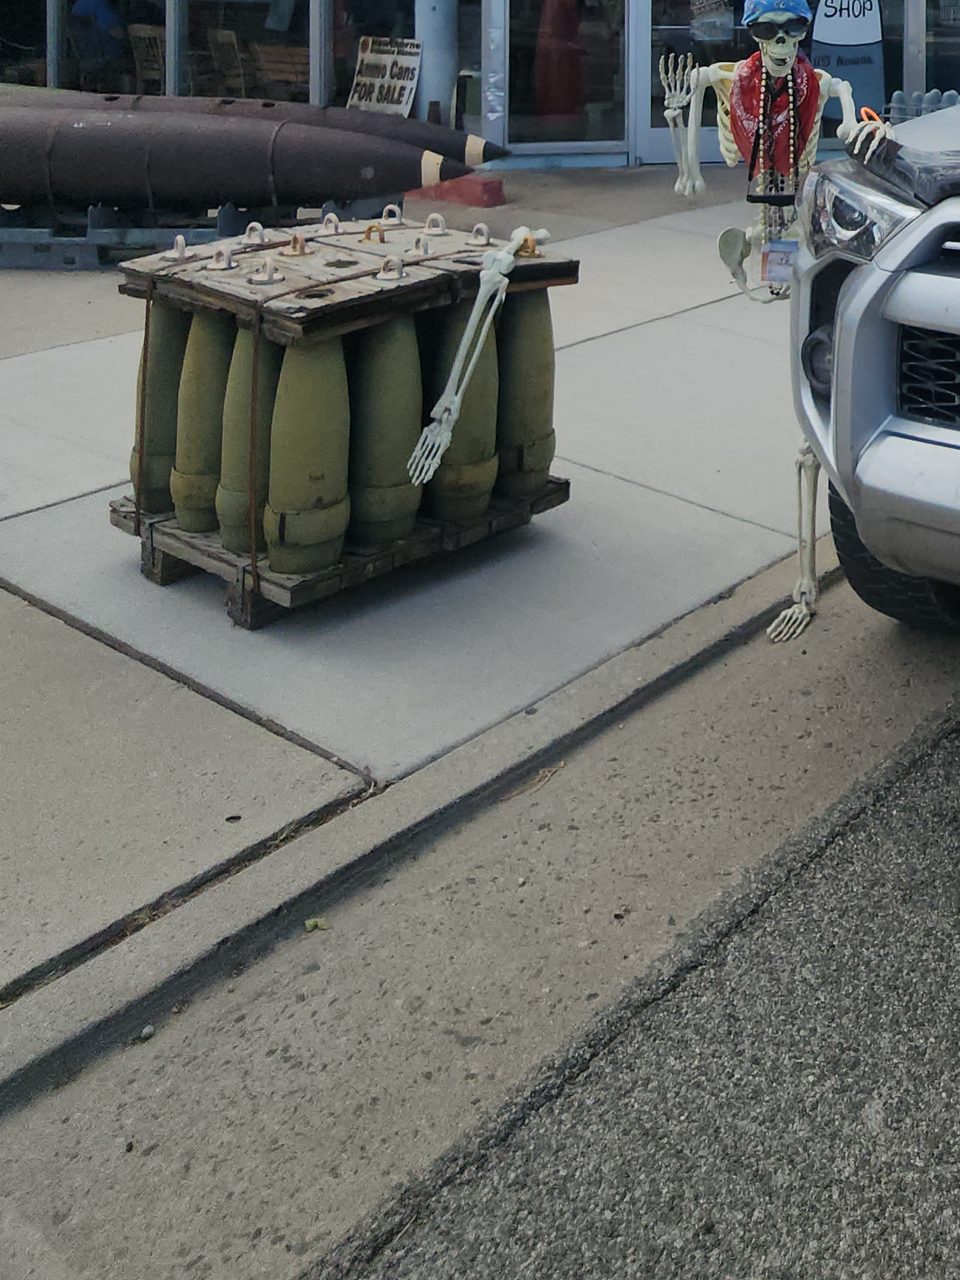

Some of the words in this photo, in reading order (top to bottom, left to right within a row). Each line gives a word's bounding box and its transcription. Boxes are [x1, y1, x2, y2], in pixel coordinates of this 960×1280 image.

[390, 61, 416, 81] Cans
[351, 82, 375, 102] FOR
[377, 85, 406, 104] SALE
